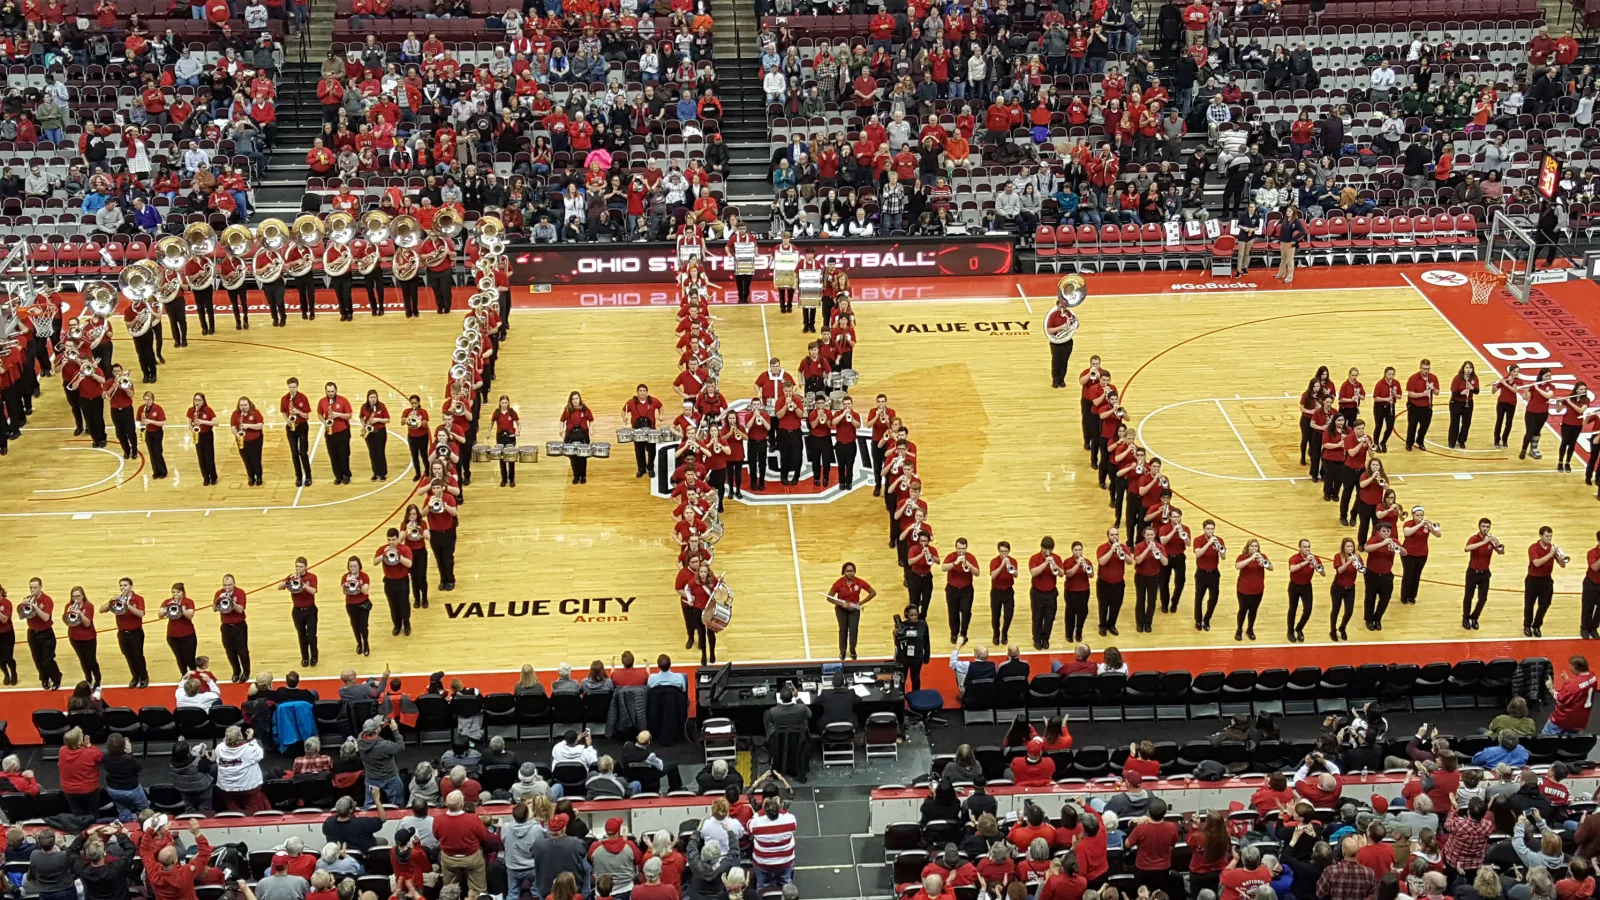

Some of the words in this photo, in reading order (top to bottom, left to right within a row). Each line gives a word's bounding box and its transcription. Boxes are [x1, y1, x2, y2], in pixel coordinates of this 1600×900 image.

[1542, 168, 1555, 195] 30
[577, 257, 640, 272] OHIO
[648, 257, 737, 271] STTE
[1171, 282, 1258, 291] #GoBucks
[889, 322, 970, 334] VALUE
[974, 321, 1031, 331] CITY
[444, 600, 551, 619] VALUE
[558, 597, 637, 615] CITY
[573, 615, 629, 623] Arena
[1584, 687, 1593, 709] 1
[1544, 787, 1567, 799] GRIFFIN
